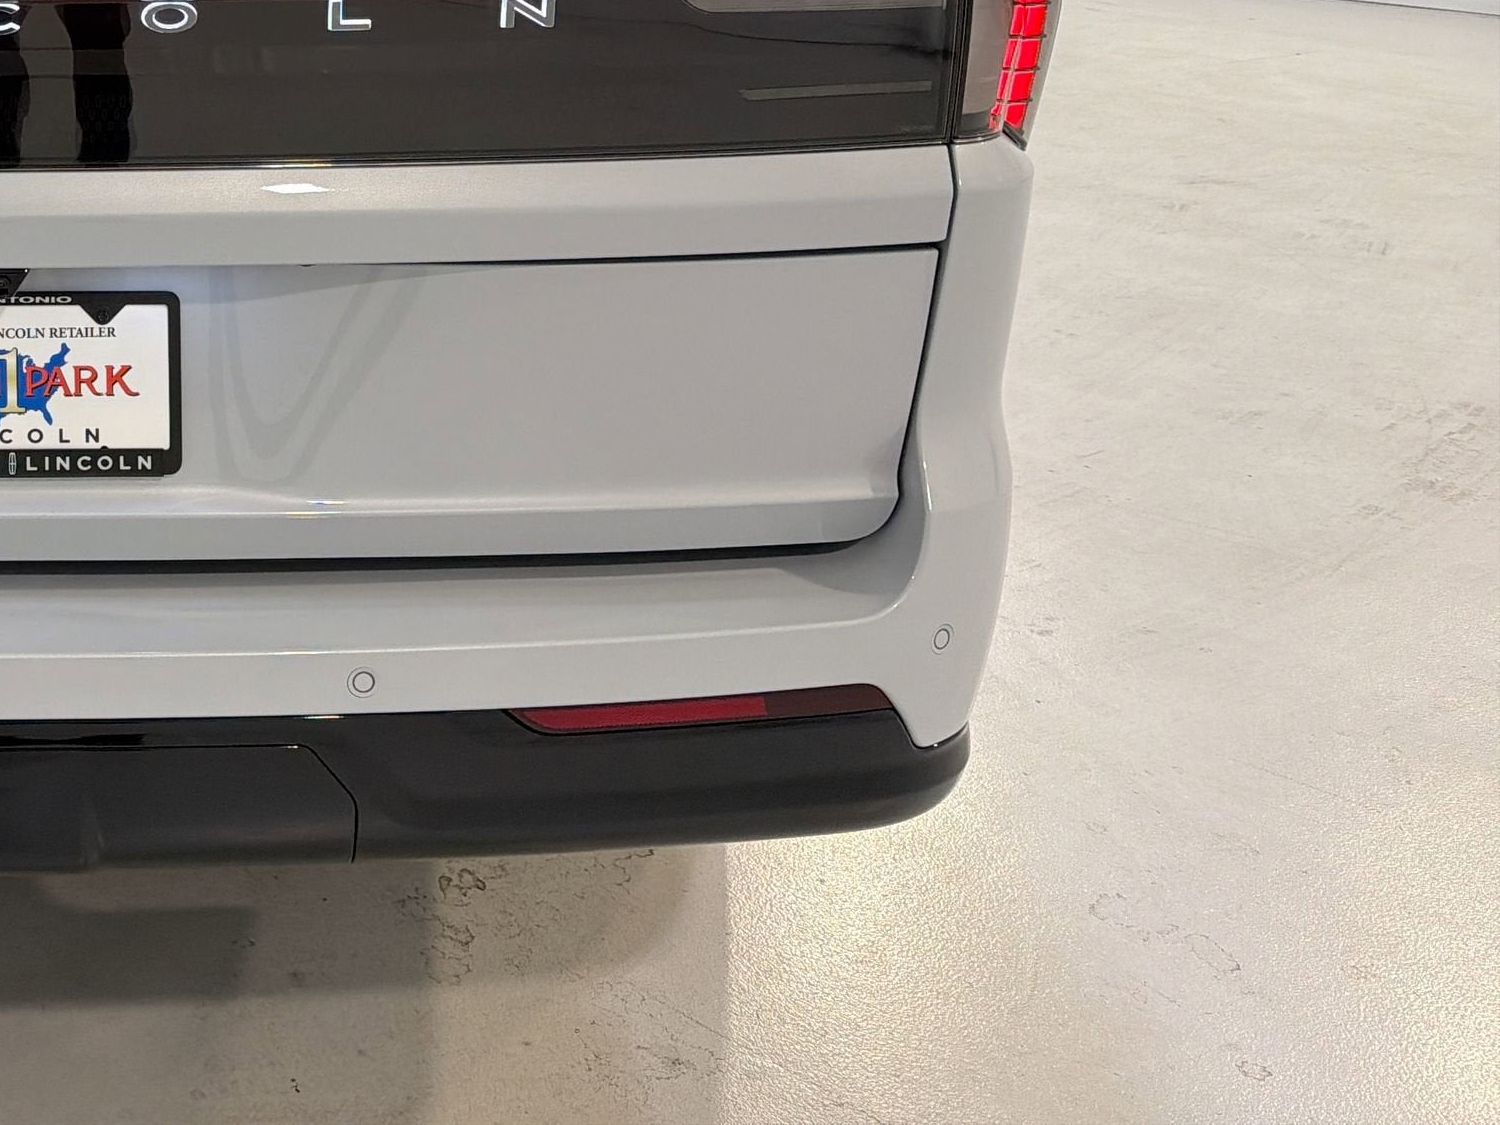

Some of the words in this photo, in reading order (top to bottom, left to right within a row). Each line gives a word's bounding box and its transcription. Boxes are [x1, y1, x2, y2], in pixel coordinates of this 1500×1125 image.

[49, 326, 116, 338] RETAILER
[25, 364, 140, 398] PARK
[25, 454, 153, 472] LINCOLN
